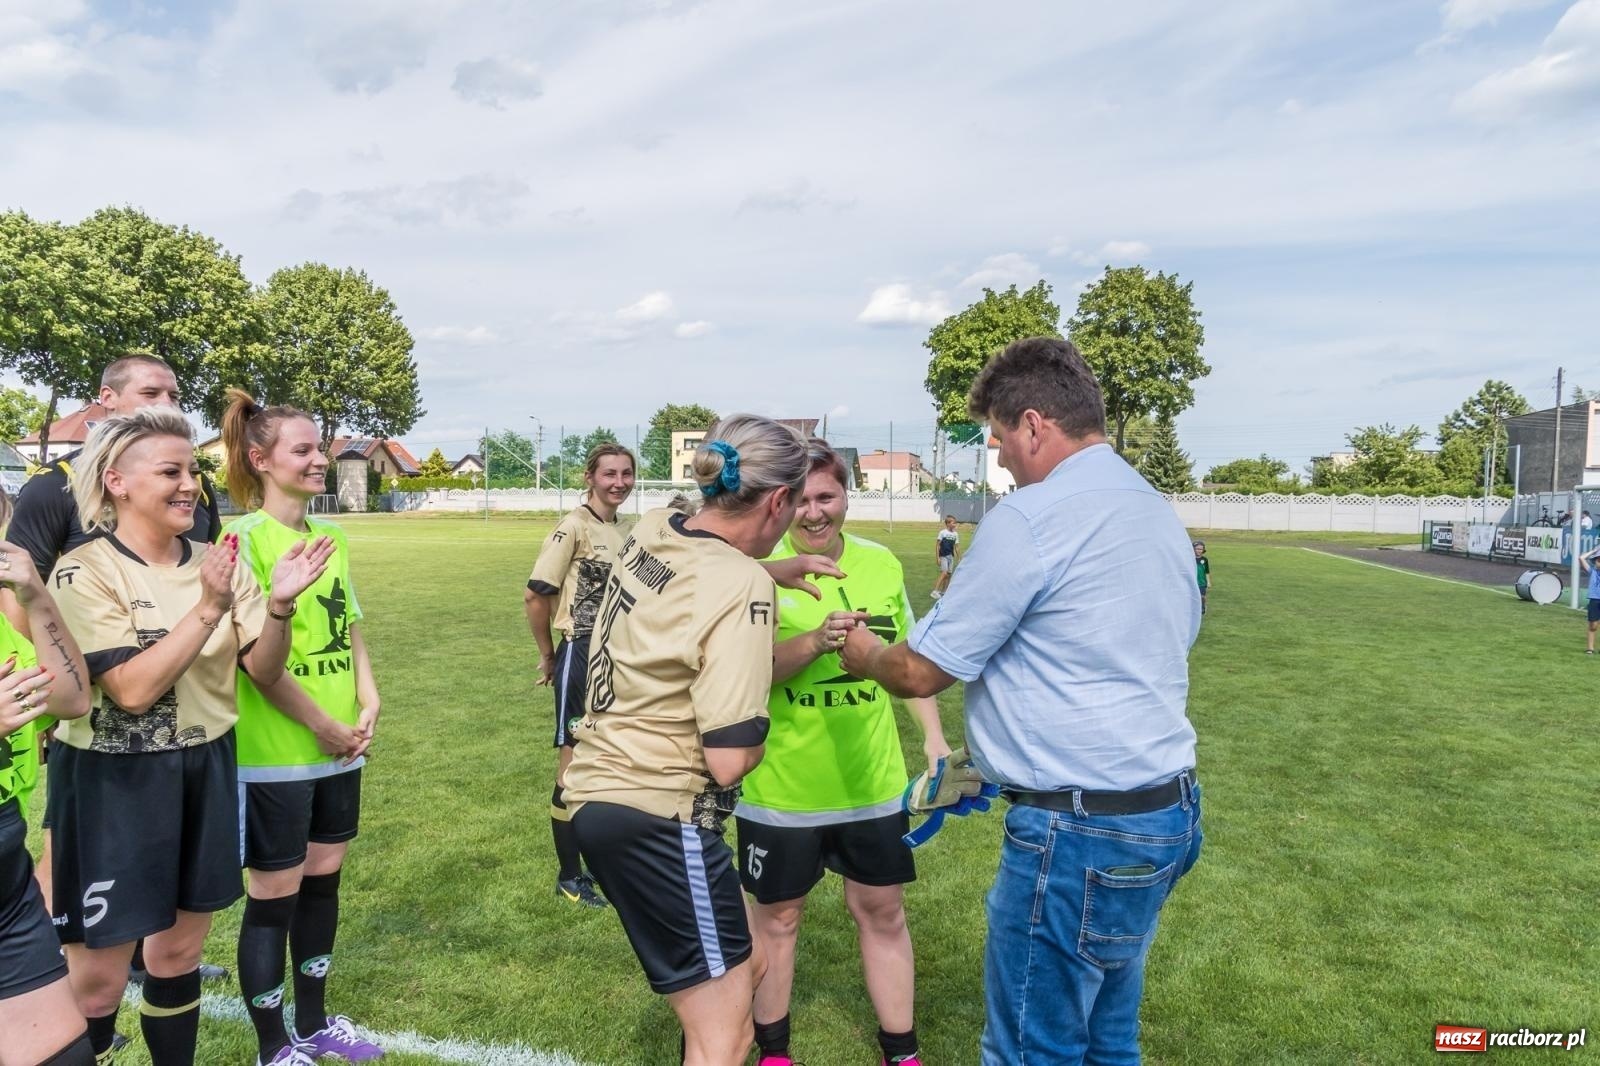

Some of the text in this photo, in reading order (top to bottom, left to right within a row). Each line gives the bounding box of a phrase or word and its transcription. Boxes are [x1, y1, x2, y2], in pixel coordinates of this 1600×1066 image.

[784, 687, 815, 707] Va
[747, 843, 769, 880] 15
[83, 880, 115, 928] 5
